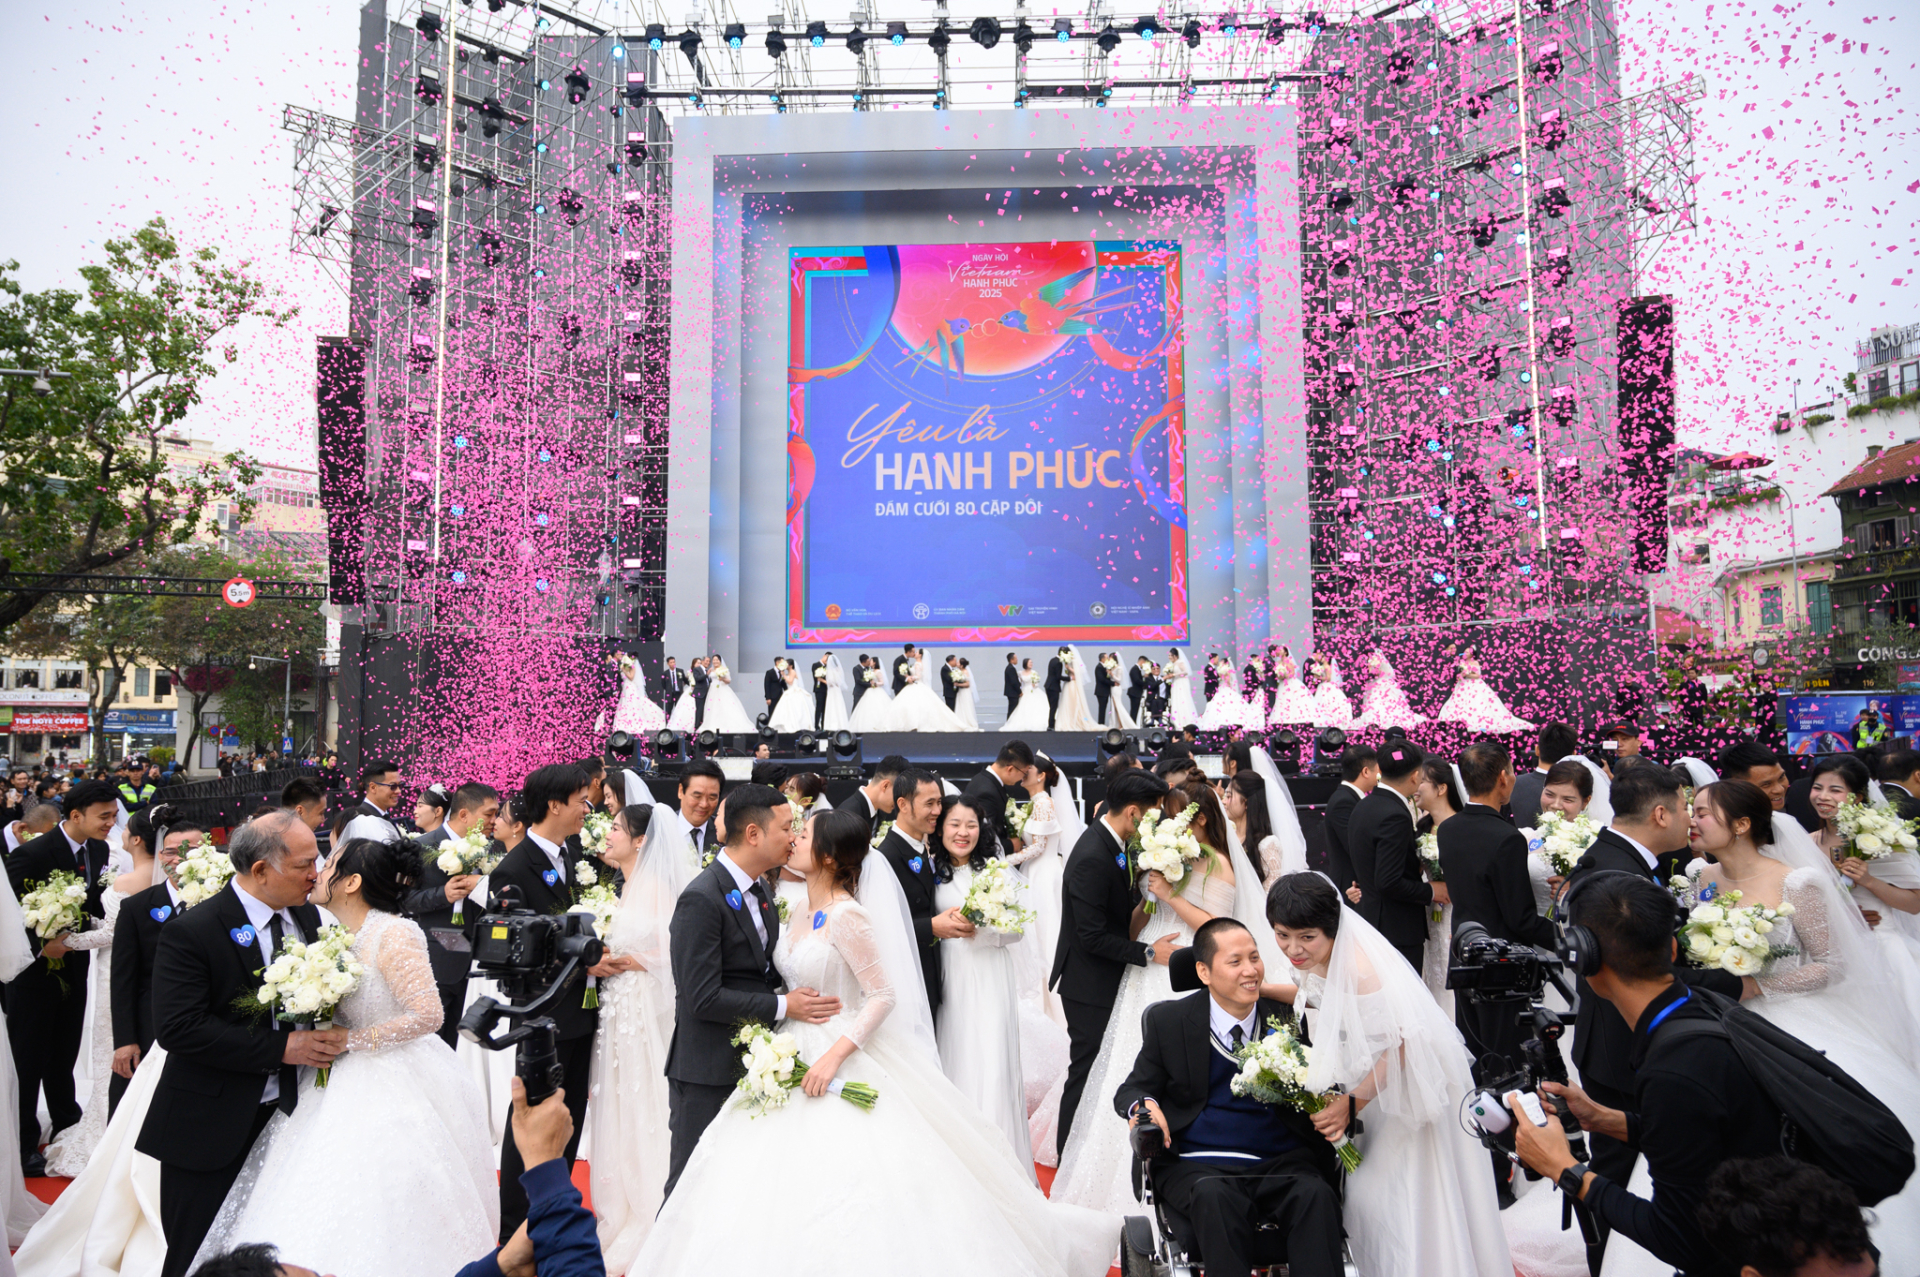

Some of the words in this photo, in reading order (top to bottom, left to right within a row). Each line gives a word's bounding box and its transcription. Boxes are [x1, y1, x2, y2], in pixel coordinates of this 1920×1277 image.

[979, 289, 1002, 298] 2025
[841, 401, 959, 469] Yêu
[957, 404, 1010, 444] là
[875, 451, 992, 495] HẠNH
[1009, 442, 1121, 489] PHÚC
[875, 500, 909, 516] ĐÁM
[914, 499, 950, 516] CƯỚI
[955, 503, 976, 516] 80
[980, 499, 1011, 517] CẶP
[1015, 498, 1042, 515] ĐÔI
[998, 604, 1024, 617] VTV
[911, 861, 921, 871] 75
[546, 874, 555, 882] 49
[732, 897, 738, 906] 1
[157, 911, 164, 919] 9
[236, 930, 252, 943] 80
